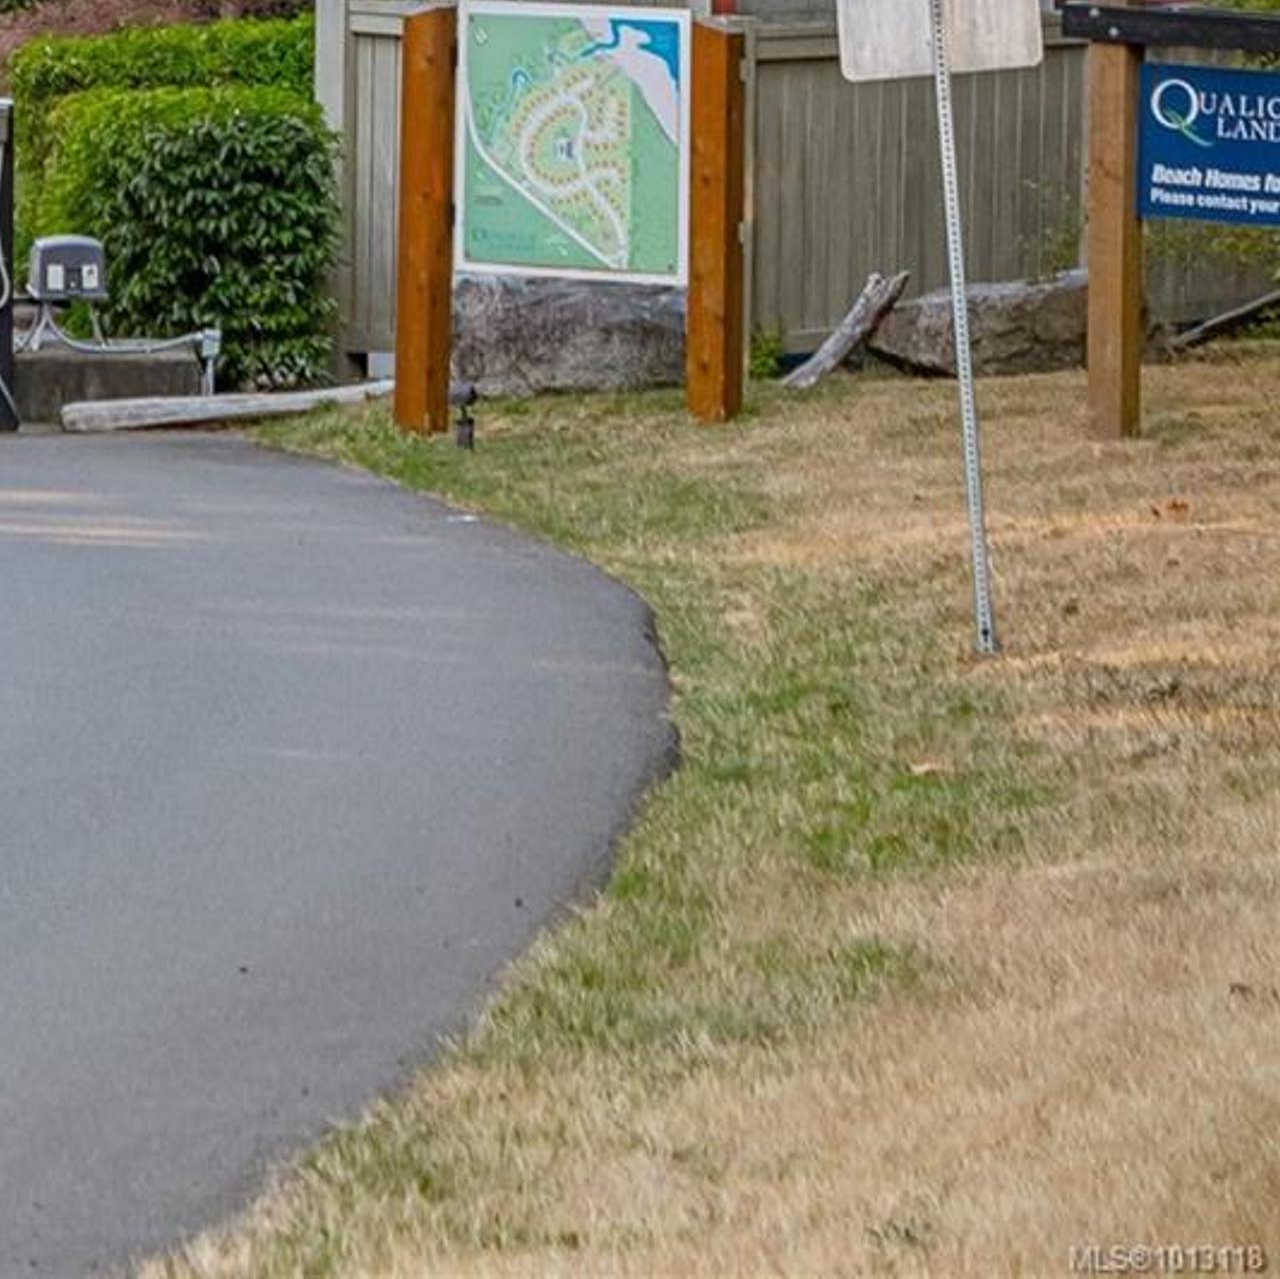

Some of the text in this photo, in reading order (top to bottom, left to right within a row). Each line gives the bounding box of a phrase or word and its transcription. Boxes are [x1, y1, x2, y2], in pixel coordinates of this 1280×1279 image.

[1151, 164, 1202, 187] Beach
[1204, 168, 1260, 191] Homes
[1150, 187, 1195, 206] Please
[1197, 193, 1248, 211] contact
